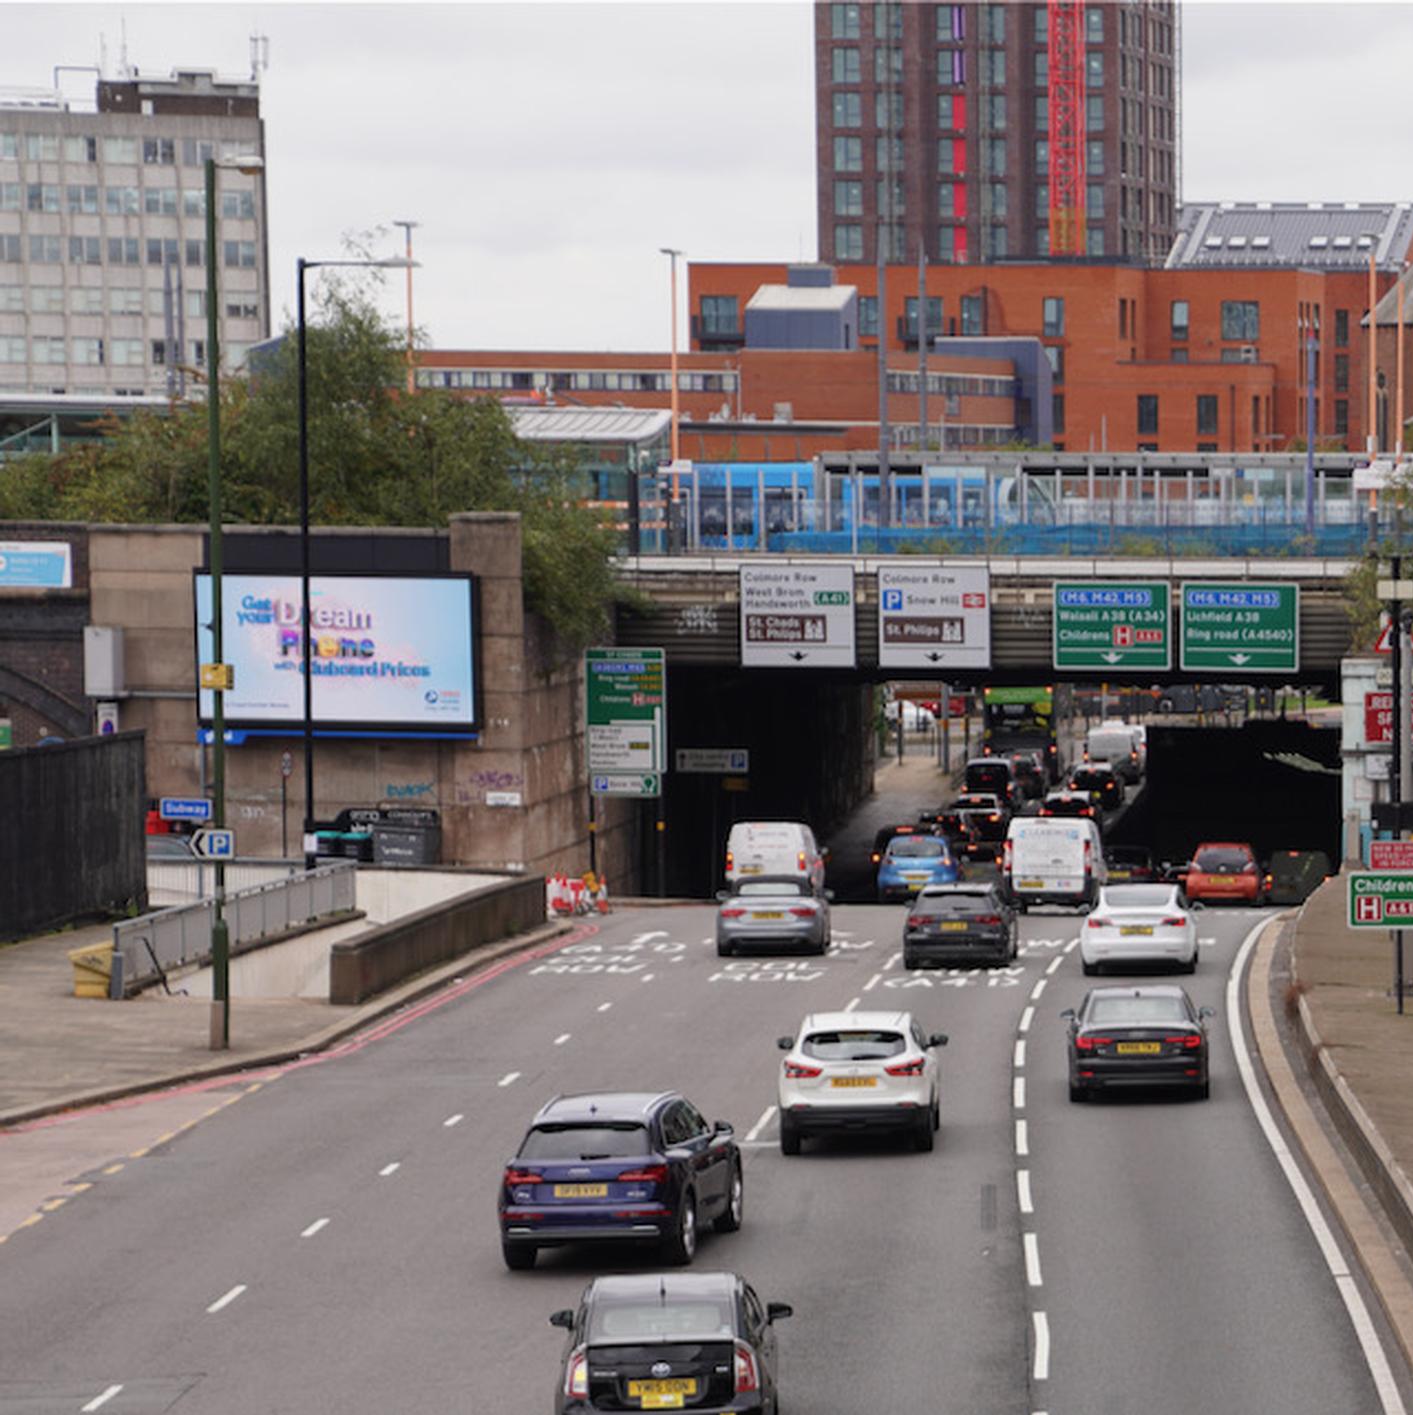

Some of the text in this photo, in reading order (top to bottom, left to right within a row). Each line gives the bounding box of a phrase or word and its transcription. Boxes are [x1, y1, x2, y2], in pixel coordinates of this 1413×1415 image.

[744, 572, 817, 583] Colmore Row
[882, 573, 955, 584] Colmore Row
[745, 587, 805, 597] West Brom
[241, 593, 272, 611] Get
[745, 599, 812, 609] Handsworth
[814, 592, 849, 605] (A41)
[906, 593, 960, 605] Snow Hill
[236, 610, 276, 627] your
[1060, 609, 1165, 622] Walsall A38 (A34)
[1187, 610, 1260, 622] Lichfield A38
[1060, 629, 1110, 641] Childrens
[1187, 628, 1294, 642] Ring road (A4540)
[380, 661, 432, 677] Prices
[165, 802, 207, 816] Subway
[212, 835, 227, 854] P
[1360, 898, 1379, 919] H
[723, 961, 828, 971] COL
[707, 971, 823, 982] ROW
